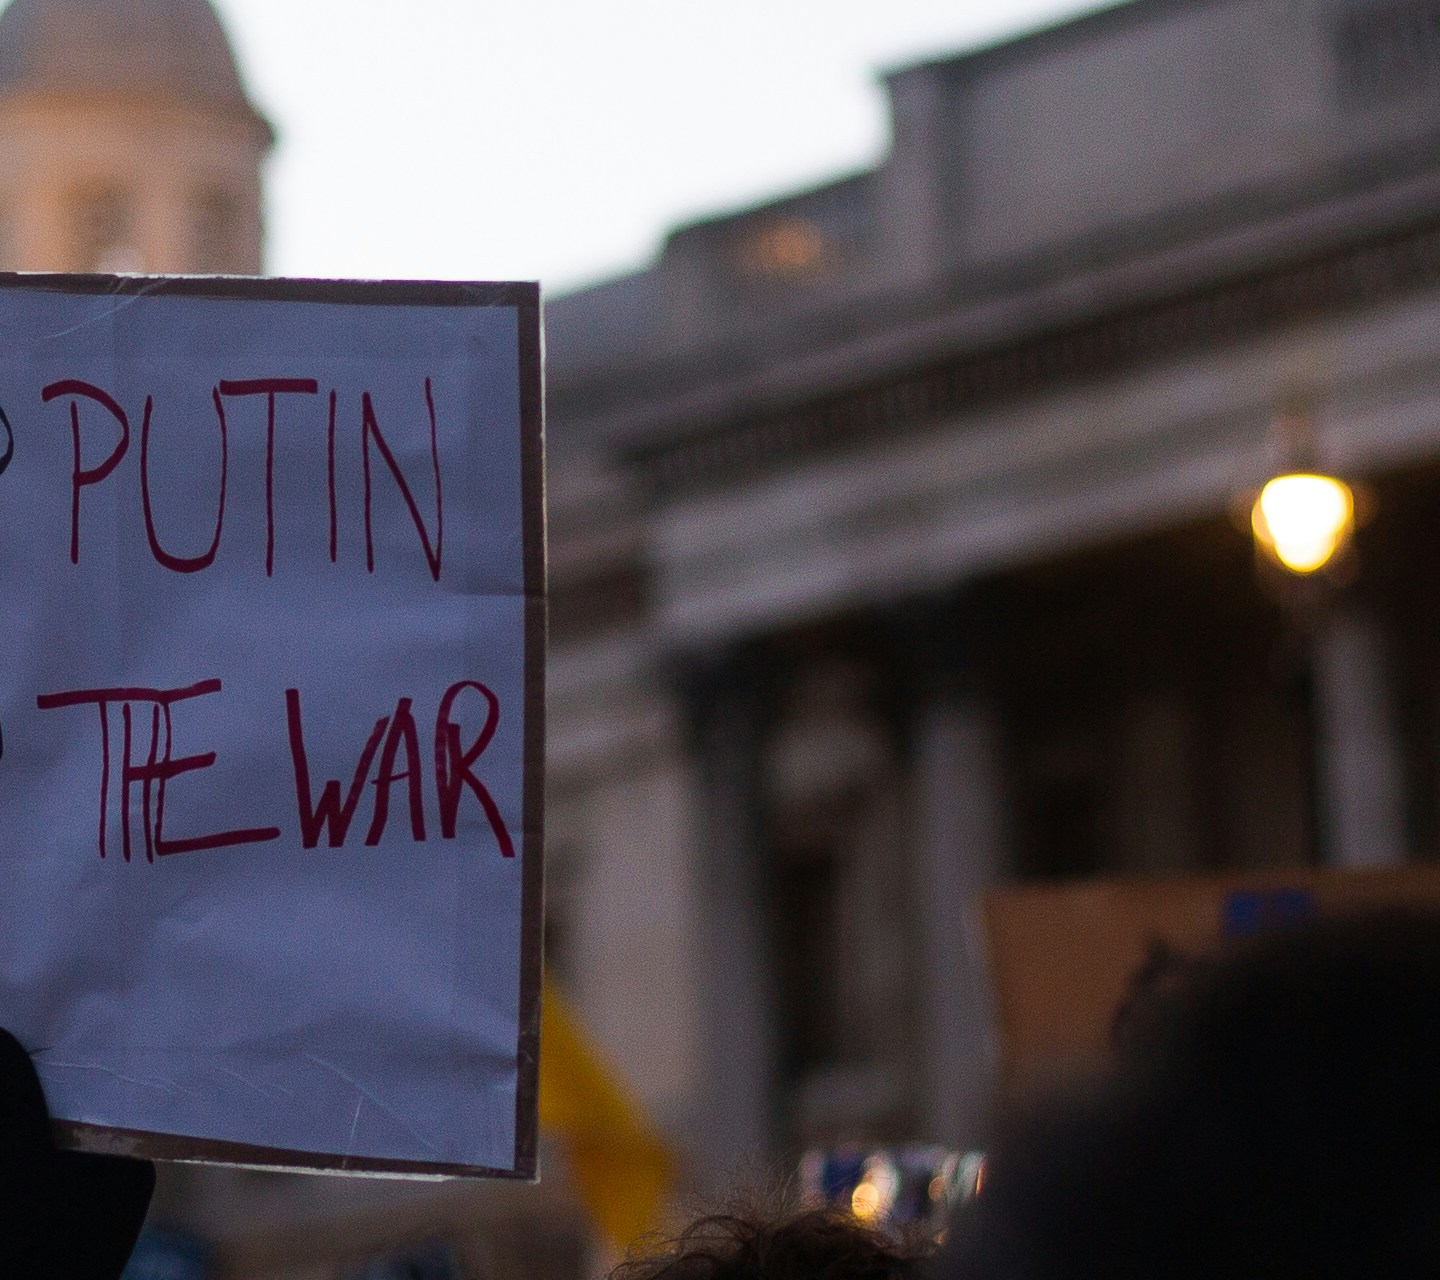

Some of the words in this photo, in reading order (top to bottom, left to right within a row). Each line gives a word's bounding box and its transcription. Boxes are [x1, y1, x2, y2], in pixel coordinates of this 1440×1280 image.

[41, 377, 443, 582] PUTIN
[37, 678, 280, 863] THE
[285, 679, 515, 858] WAR
